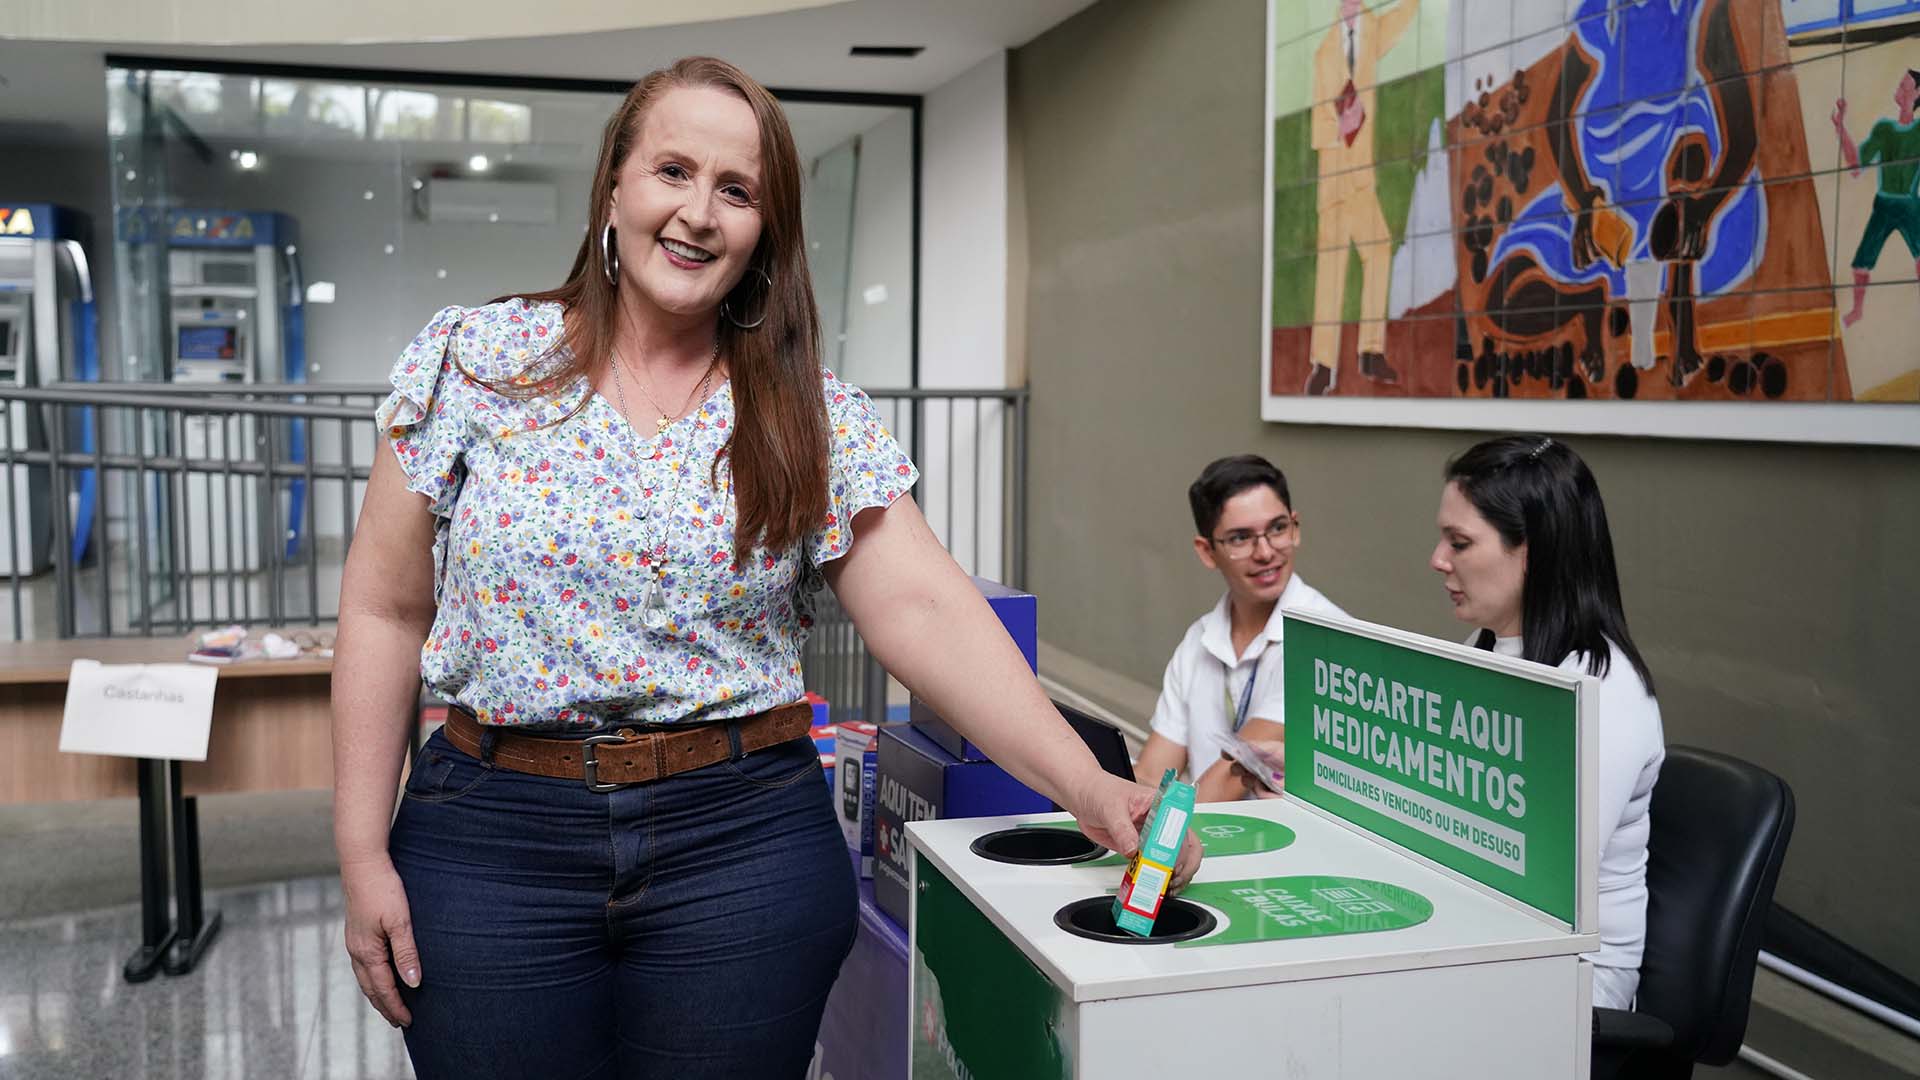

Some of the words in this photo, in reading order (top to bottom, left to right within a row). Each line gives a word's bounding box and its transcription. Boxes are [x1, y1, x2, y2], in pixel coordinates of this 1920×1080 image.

[103, 684, 184, 704] Castanhas
[1314, 658, 1442, 735] DESCARTE
[1449, 700, 1523, 762] AQUI
[1313, 704, 1527, 818] MEDICAMENTOS
[879, 774, 906, 819] AQUI
[908, 790, 937, 821] TEM
[1317, 762, 1380, 802] DOMICILIARES
[1382, 789, 1433, 826] VENCIDOS
[1435, 812, 1451, 832] OU
[1452, 820, 1469, 841] EM
[1472, 828, 1521, 861] DESUSO
[1232, 887, 1258, 896] E
[1264, 888, 1334, 922] CAIXAS
[1244, 896, 1308, 928] BULAS
